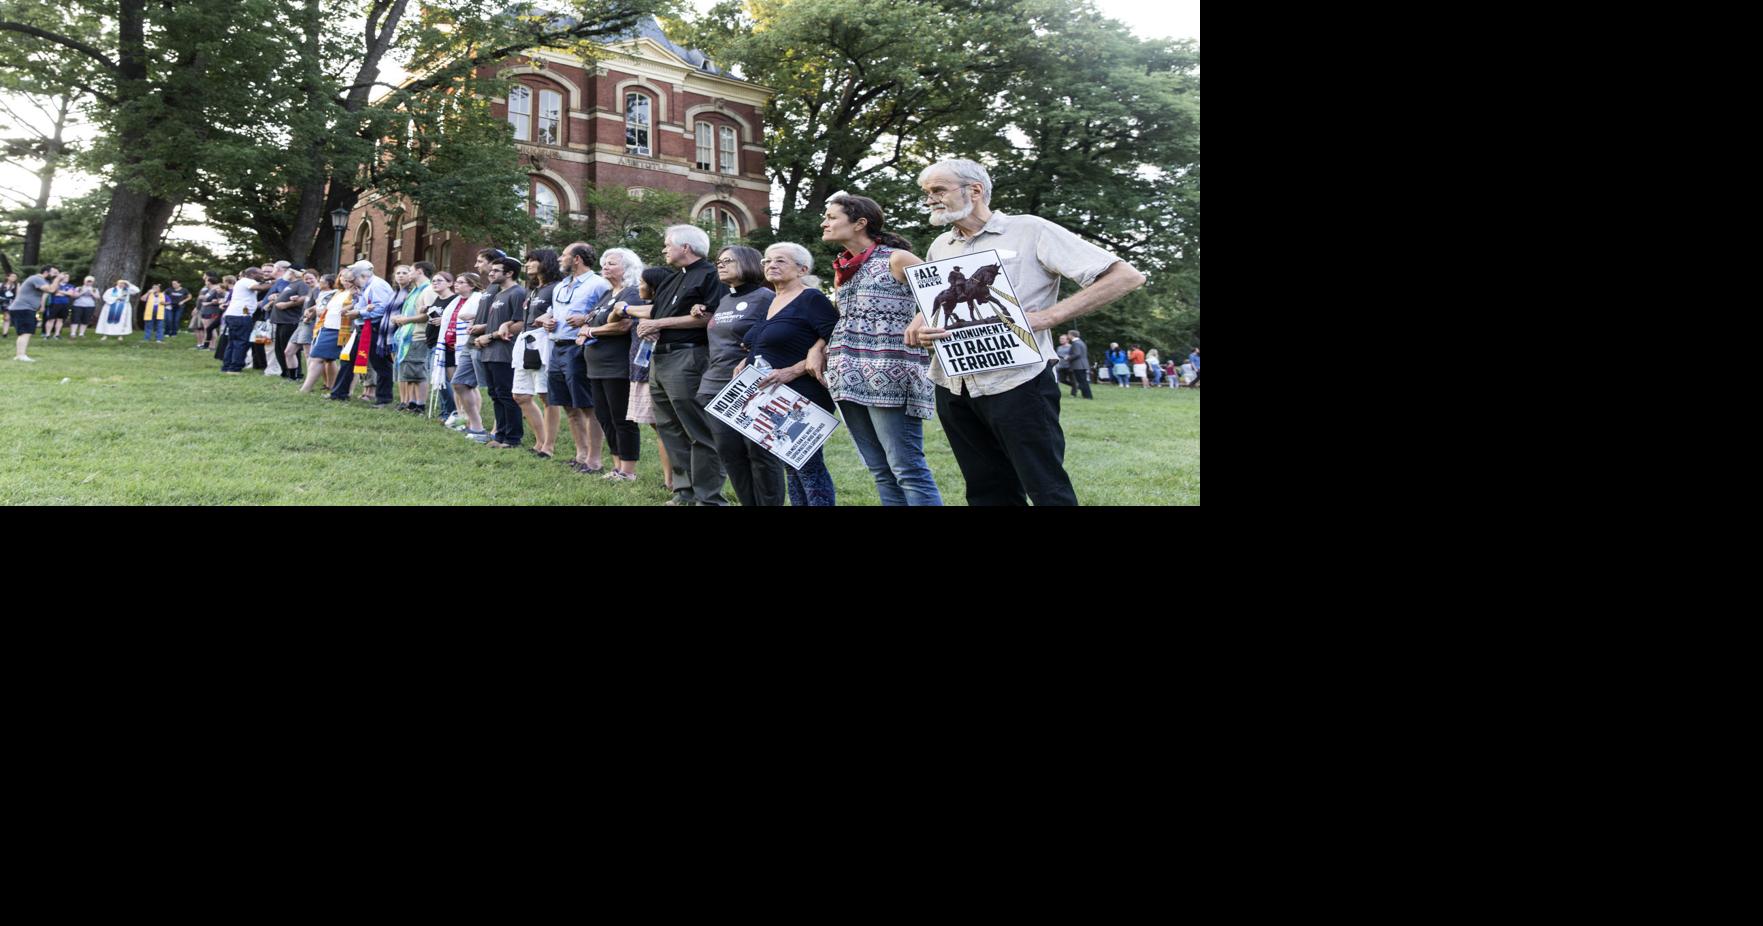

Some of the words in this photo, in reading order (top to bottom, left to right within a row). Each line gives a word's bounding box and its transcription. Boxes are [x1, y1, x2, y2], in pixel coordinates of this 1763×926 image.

[914, 265, 940, 280] #A12
[952, 323, 1011, 340] MONUMENTS
[943, 342, 964, 358] TO
[964, 334, 1019, 356] RACIAL
[949, 350, 1015, 373] TERROR!
[713, 400, 729, 414] NO
[722, 380, 748, 404] UNITY
[723, 395, 747, 419] WITHOUT
